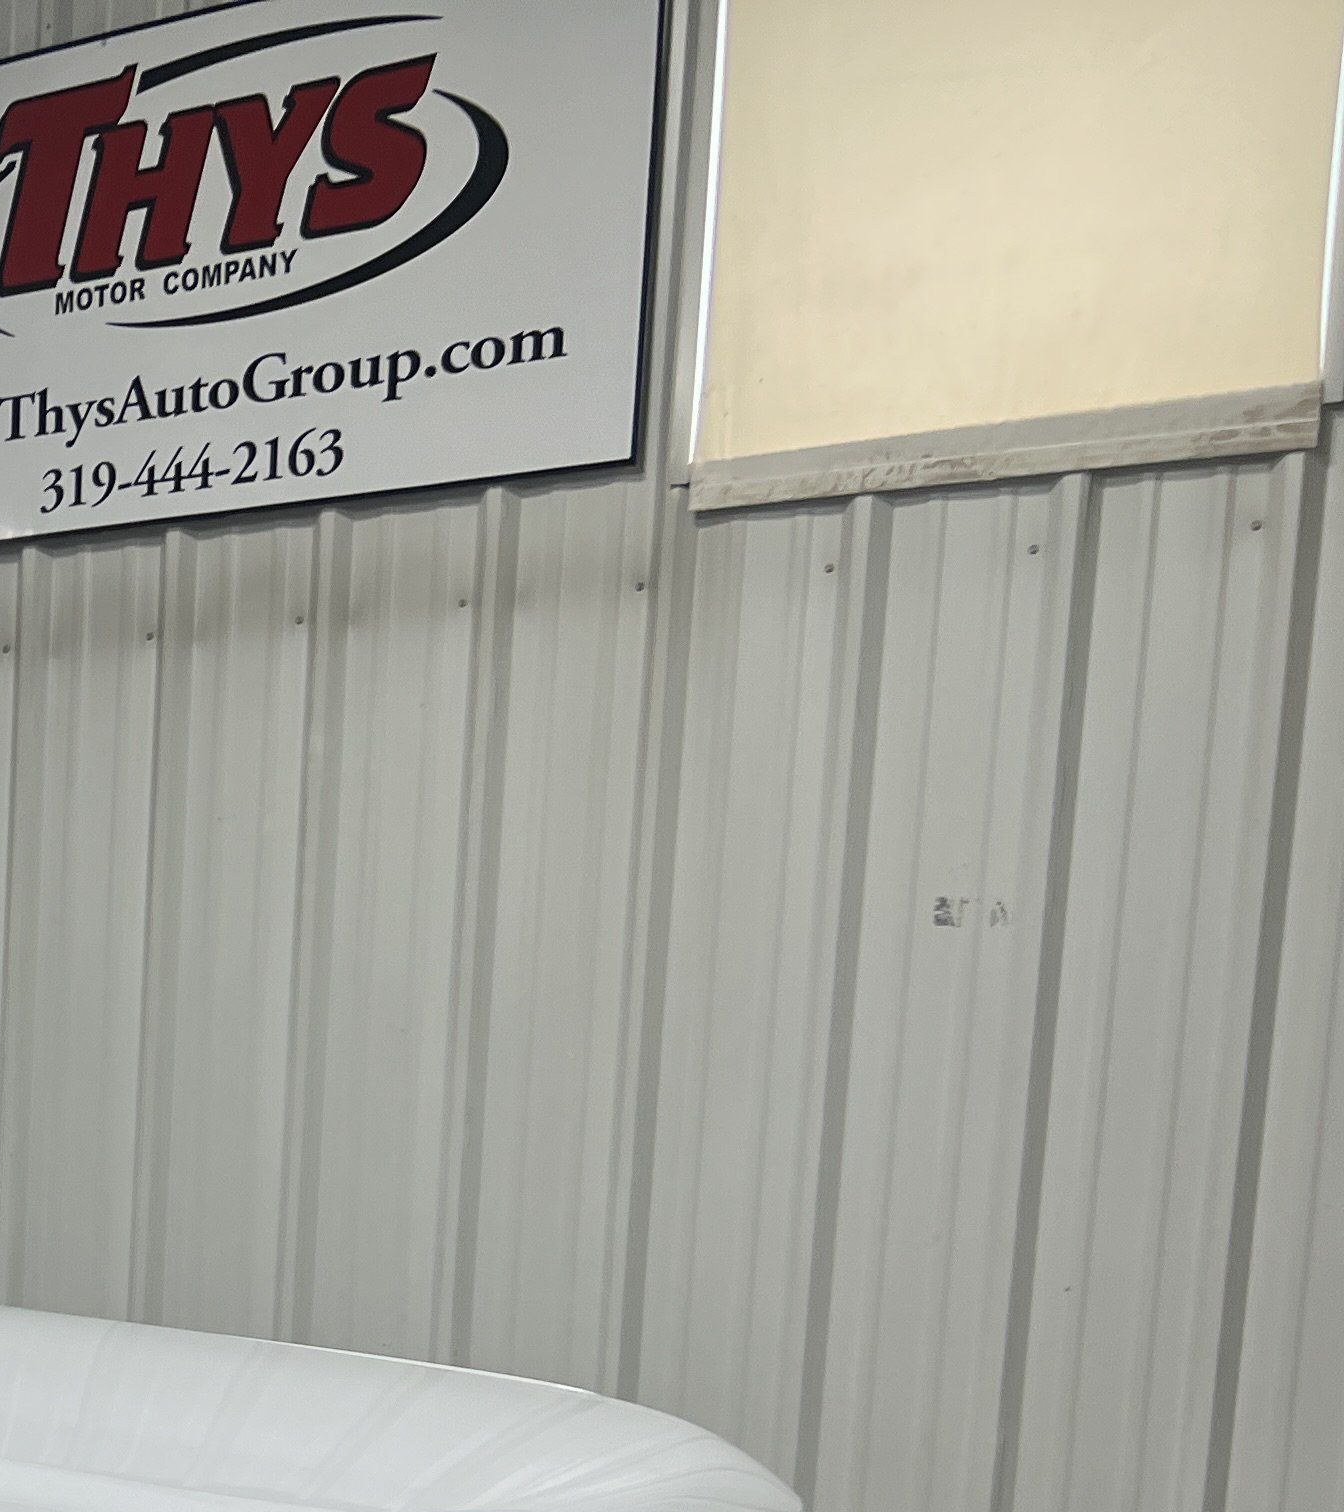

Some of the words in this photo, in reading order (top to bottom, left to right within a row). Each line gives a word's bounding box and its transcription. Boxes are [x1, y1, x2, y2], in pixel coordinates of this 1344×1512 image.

[54, 276, 147, 316] MOTOR
[162, 249, 299, 296] COMPANY
[40, 428, 346, 513] 319-444-2163
